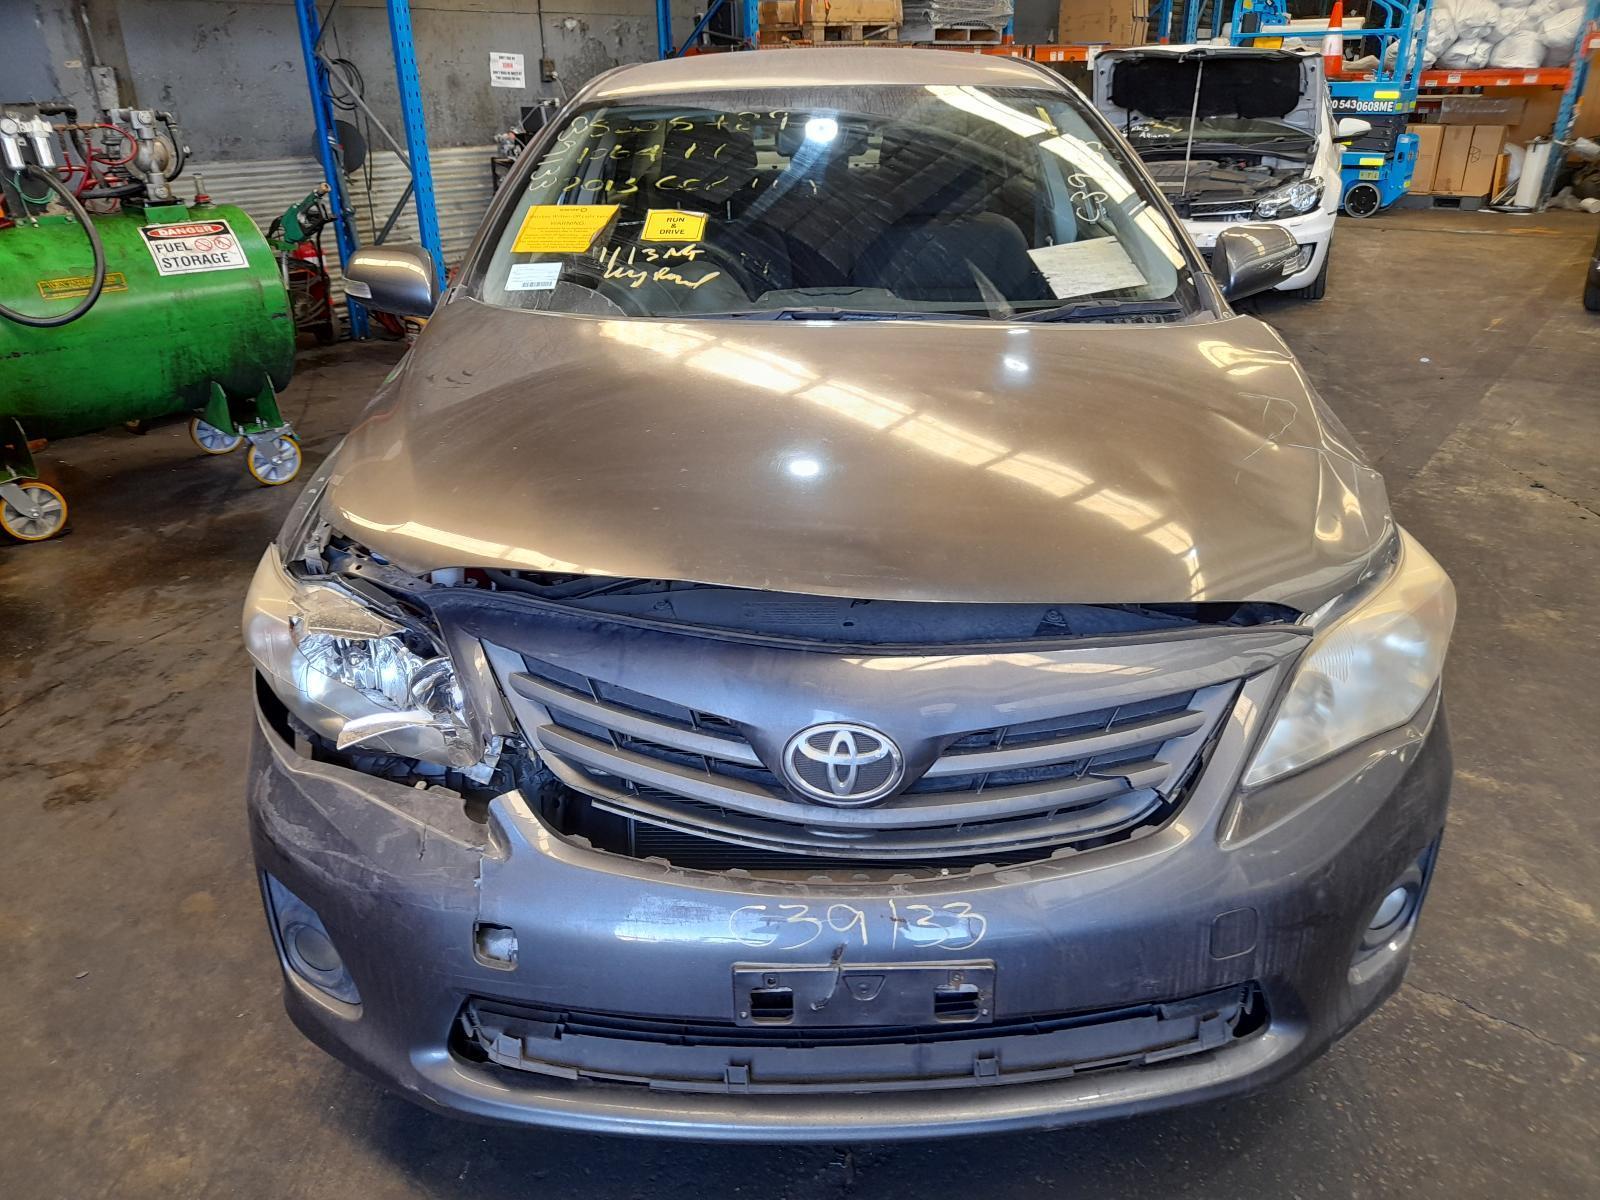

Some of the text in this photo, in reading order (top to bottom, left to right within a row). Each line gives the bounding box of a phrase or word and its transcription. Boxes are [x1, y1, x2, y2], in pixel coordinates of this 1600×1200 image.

[1339, 99, 1357, 109] 543
[1356, 101, 1394, 112] 0608ME
[157, 225, 213, 237] DANGER
[155, 241, 193, 253] FUEL
[162, 252, 231, 269] STORAGE
[728, 898, 987, 950] C39133
